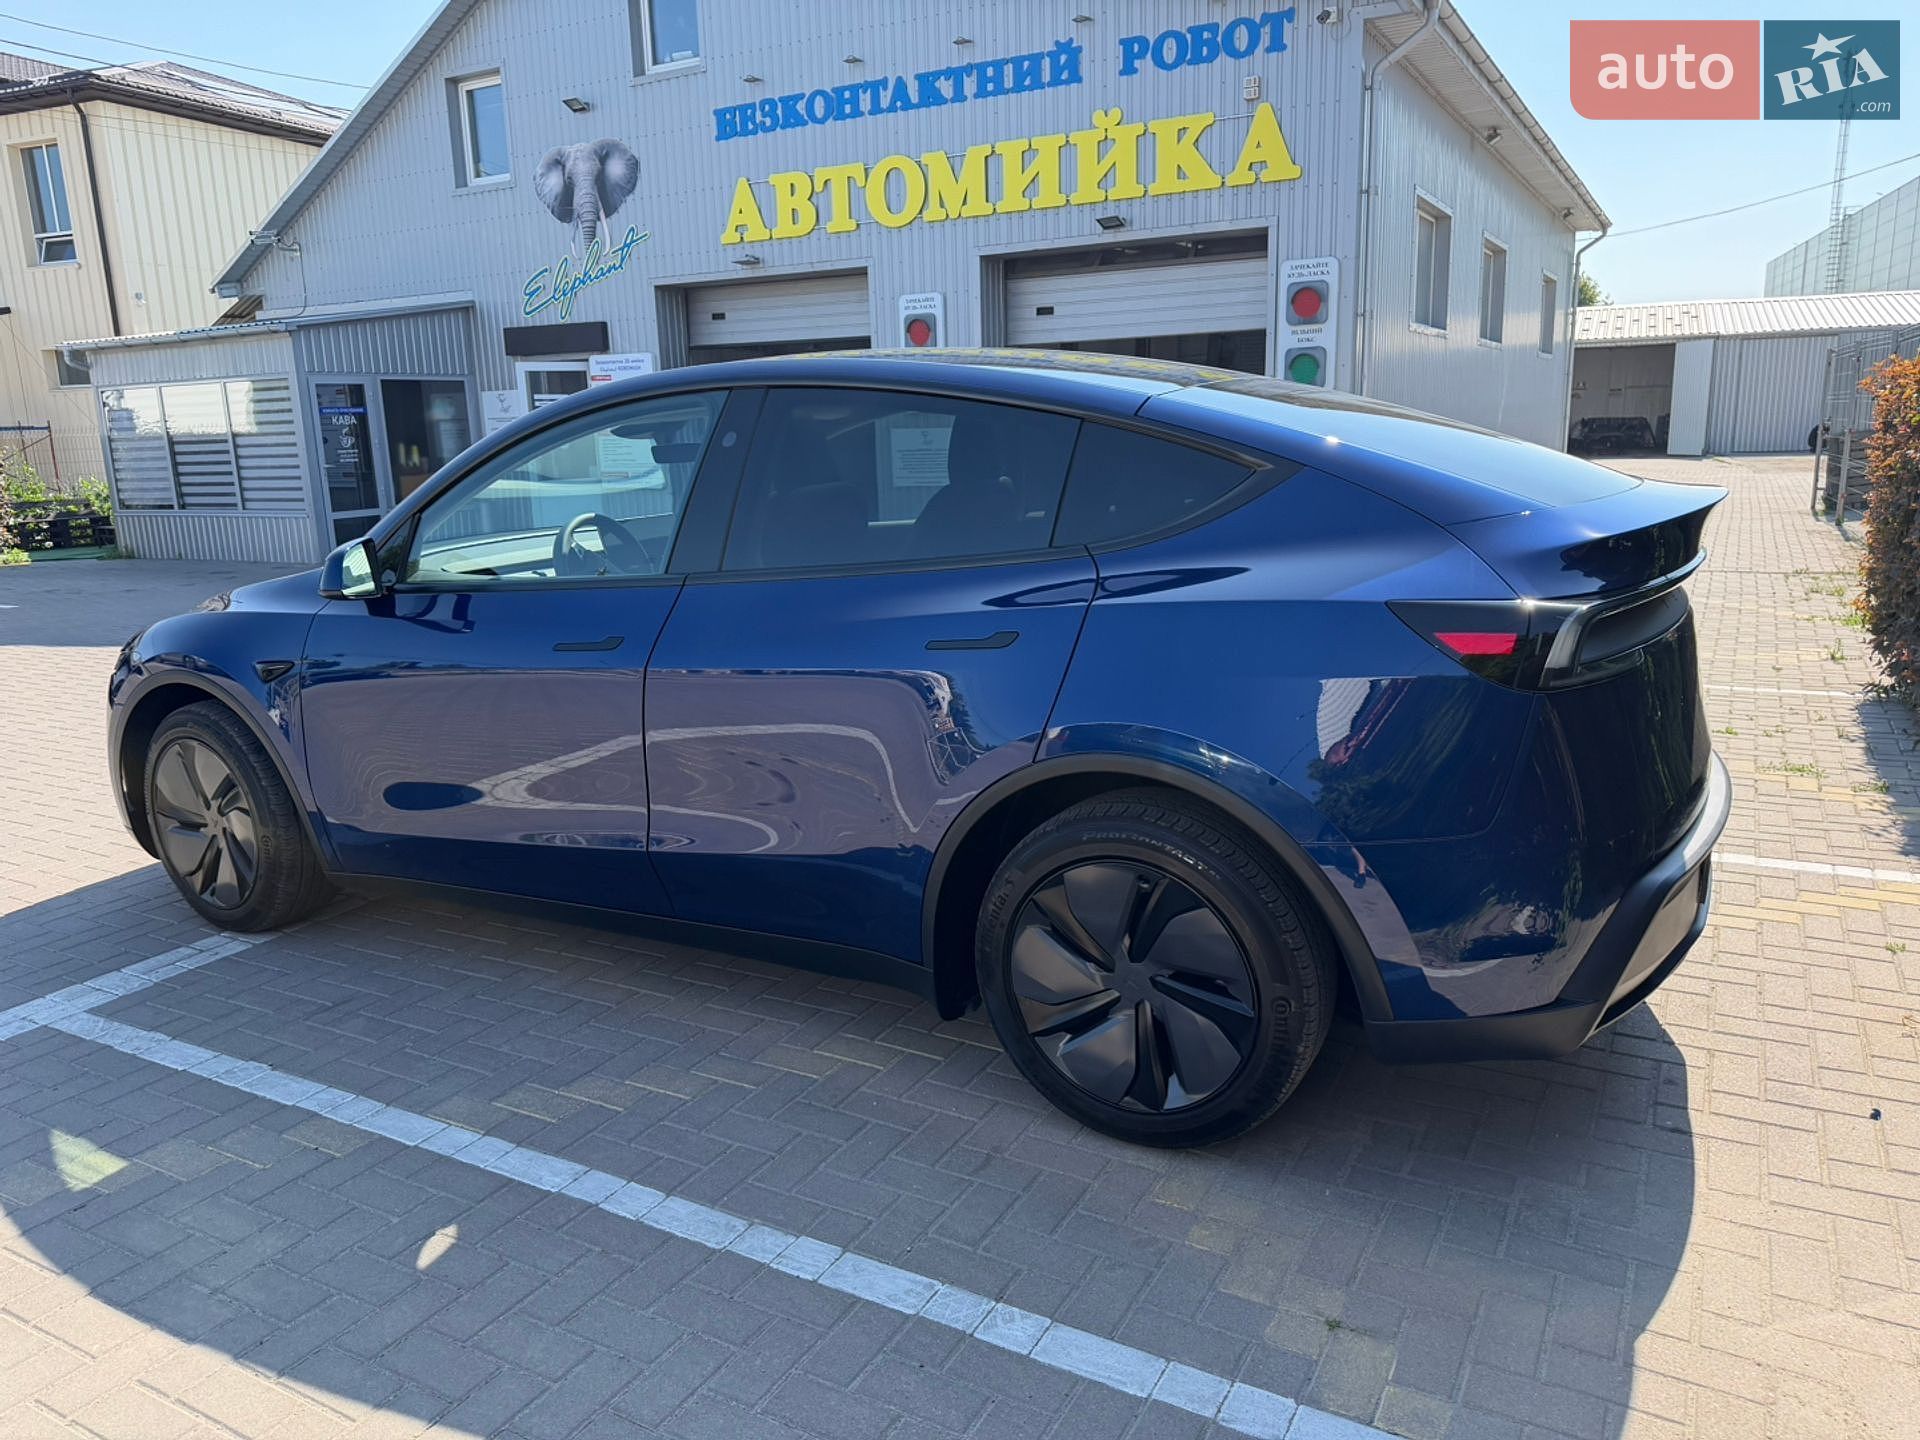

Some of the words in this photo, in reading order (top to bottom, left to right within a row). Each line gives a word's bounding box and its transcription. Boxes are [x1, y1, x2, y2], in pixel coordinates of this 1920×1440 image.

[714, 37, 1083, 141] БЕЗКОНТАКТНИЙ
[1119, 7, 1296, 76] РОБОТ
[721, 102, 1302, 245] АВТОМИЙКА
[523, 224, 650, 322] Elephant
[331, 415, 358, 425] КАВА
